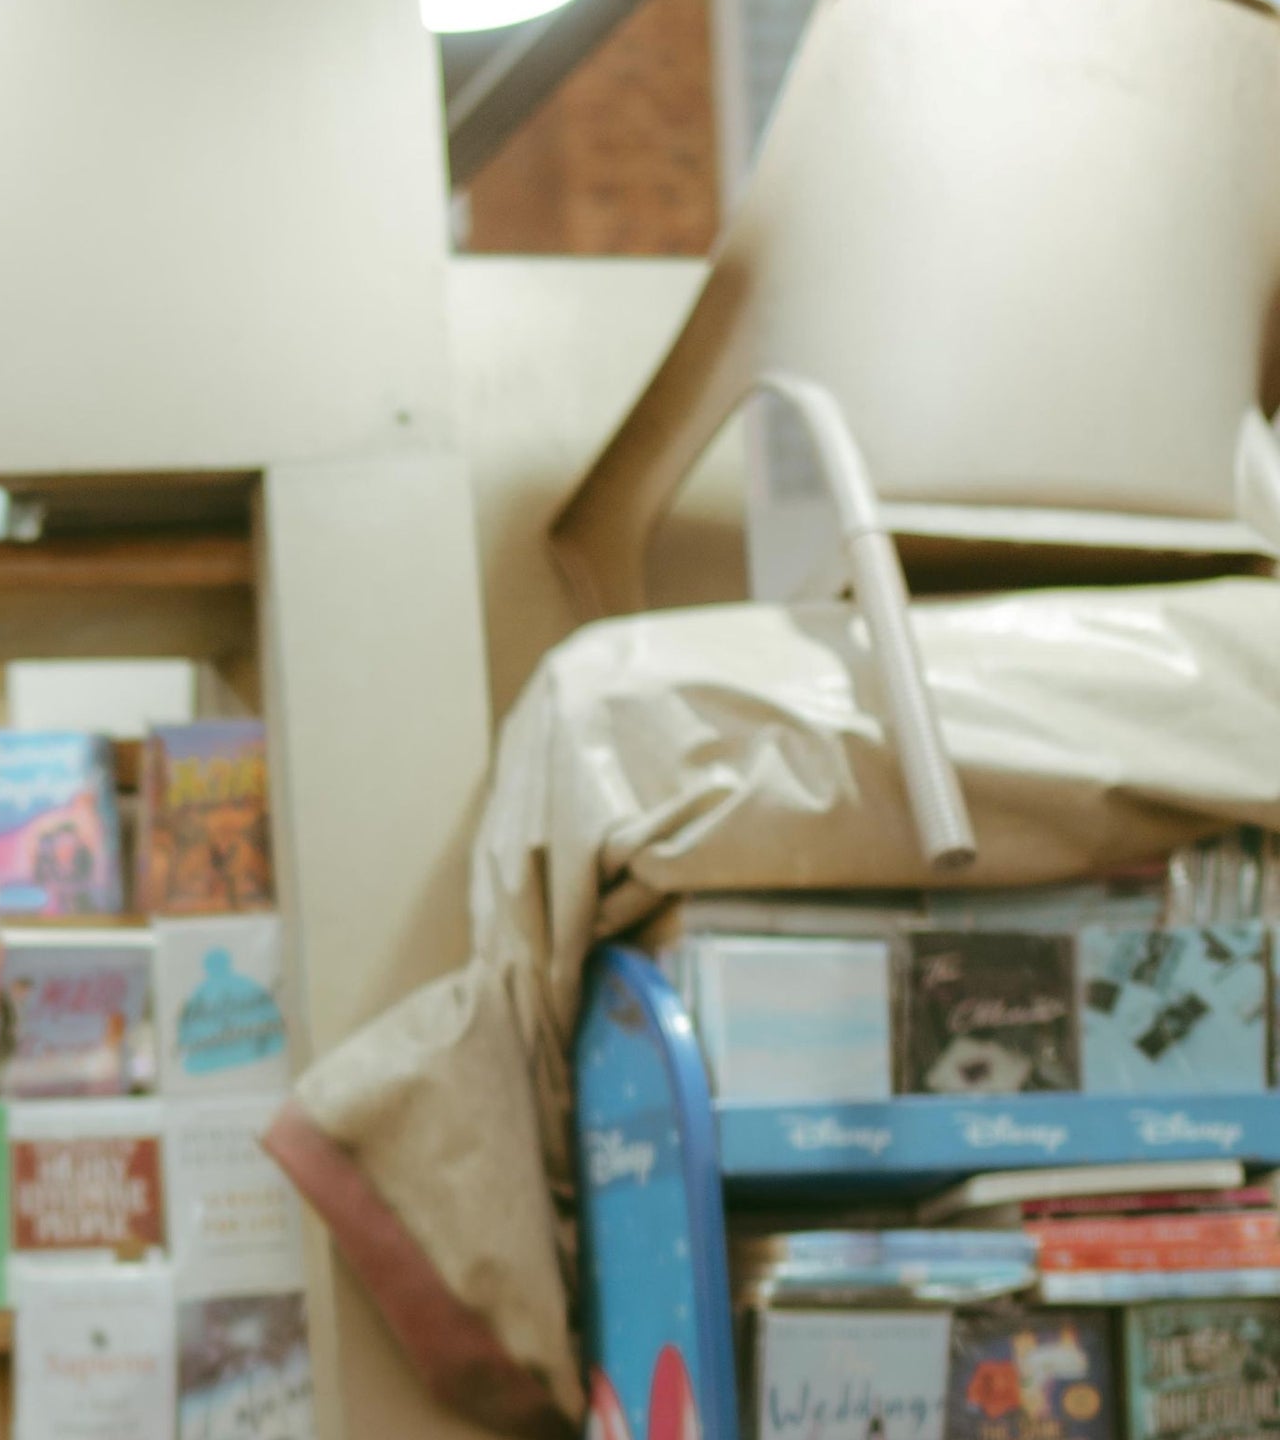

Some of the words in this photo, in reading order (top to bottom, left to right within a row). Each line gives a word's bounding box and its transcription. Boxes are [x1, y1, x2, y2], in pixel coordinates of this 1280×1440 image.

[776, 1115, 893, 1156] Disney
[953, 1112, 1068, 1154] Disney
[1129, 1109, 1243, 1151] Disney
